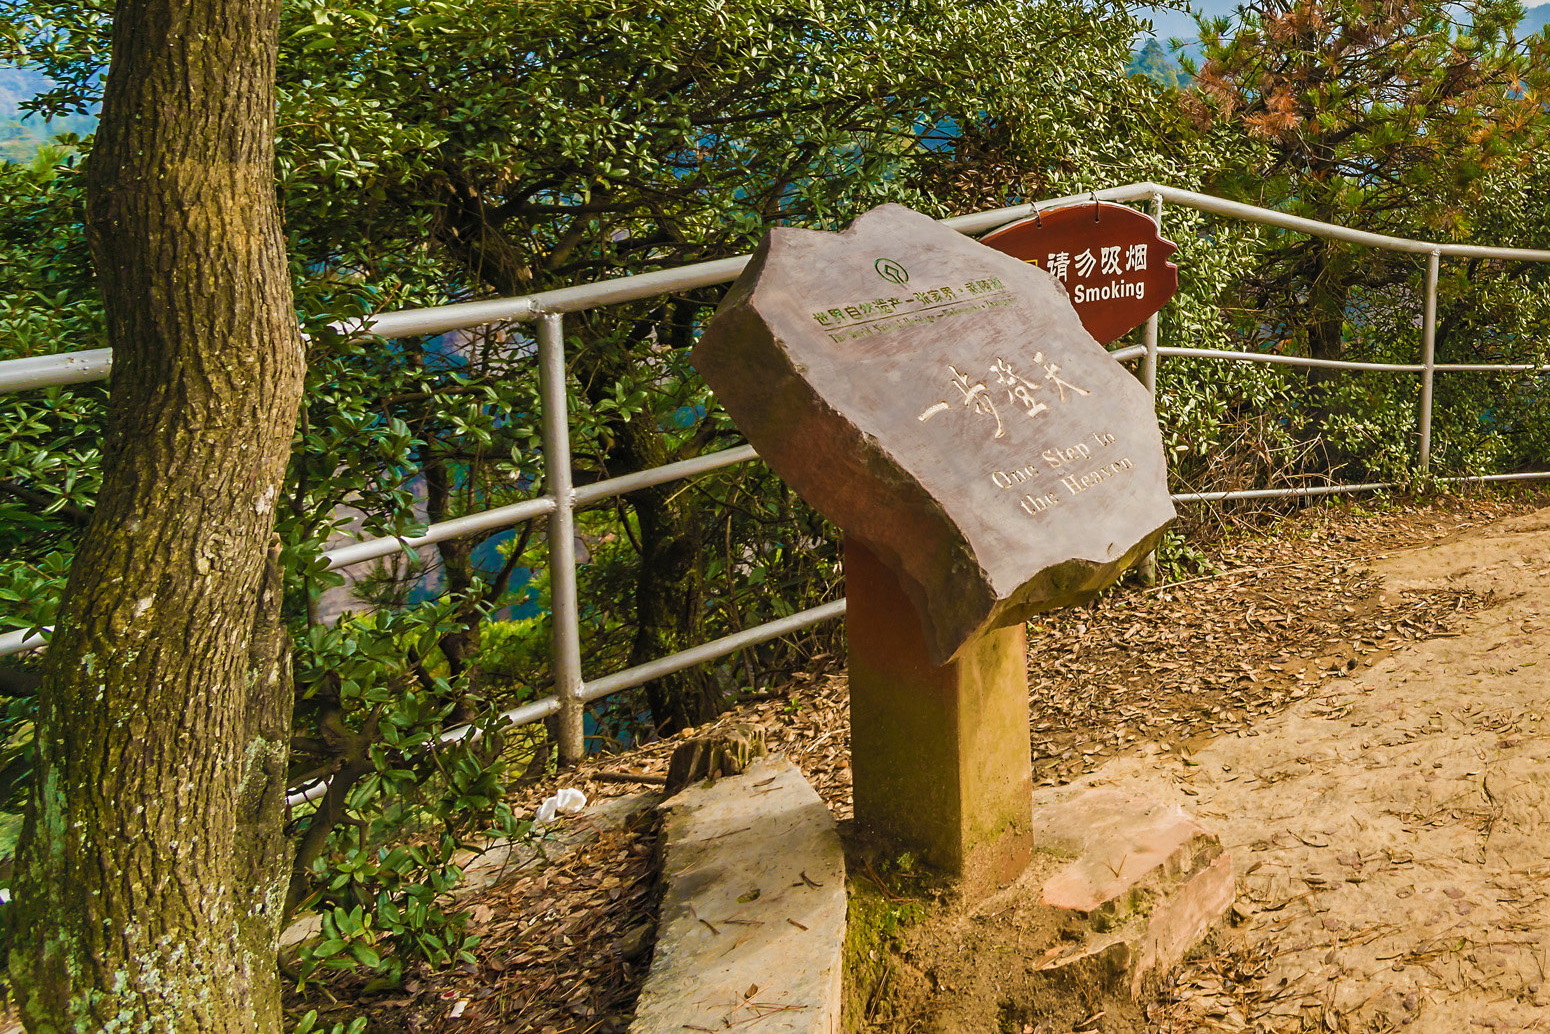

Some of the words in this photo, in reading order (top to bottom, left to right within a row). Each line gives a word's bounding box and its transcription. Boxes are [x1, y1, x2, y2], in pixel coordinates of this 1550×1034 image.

[1046, 244, 1148, 282] 请勿吸烟
[1074, 279, 1145, 304] Smoking
[991, 464, 1039, 489] One
[1042, 441, 1092, 469] Step
[1093, 431, 1116, 447] to
[1020, 492, 1059, 515] the
[1060, 456, 1135, 495] Heaven
